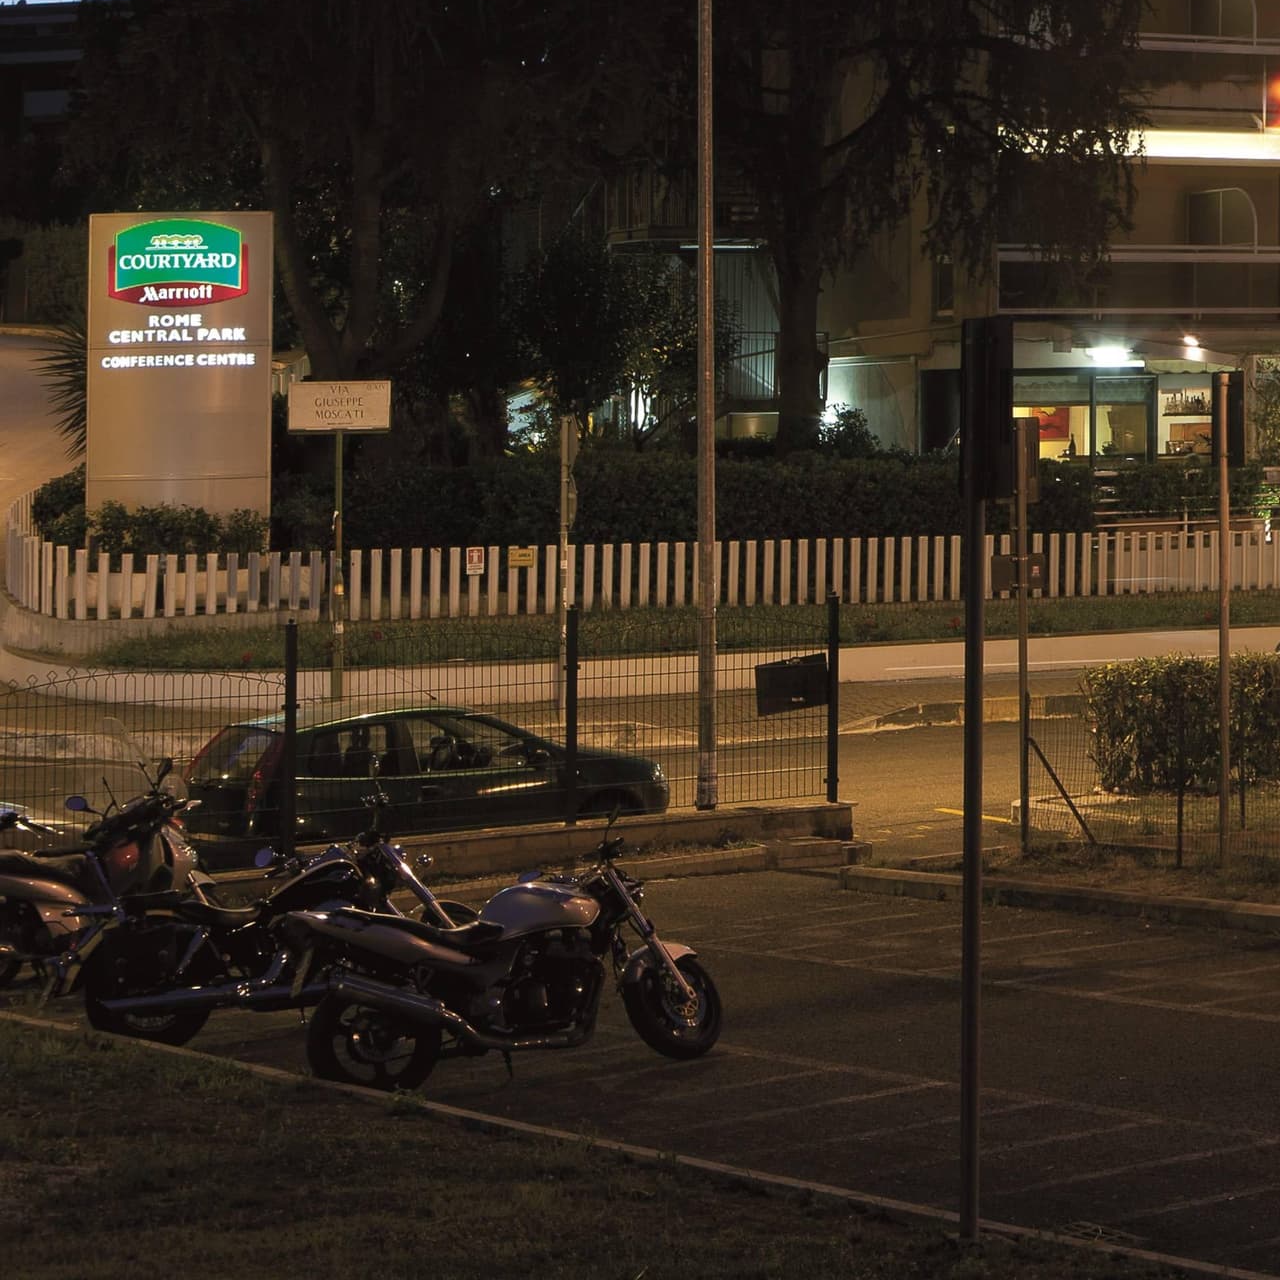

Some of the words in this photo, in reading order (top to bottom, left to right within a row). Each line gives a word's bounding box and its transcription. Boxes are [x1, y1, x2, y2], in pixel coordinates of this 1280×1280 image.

[119, 253, 237, 269] COURTYARD
[139, 285, 213, 303] Marriott
[148, 313, 202, 328] ROME
[109, 329, 193, 343] CENTRAL
[197, 327, 246, 341] PARK
[101, 354, 194, 368] CONFERENCE
[196, 353, 256, 366] CENTRE
[330, 385, 350, 394] VIA
[314, 397, 364, 408] GIUSEPPE
[315, 409, 364, 419] MOSCATI
